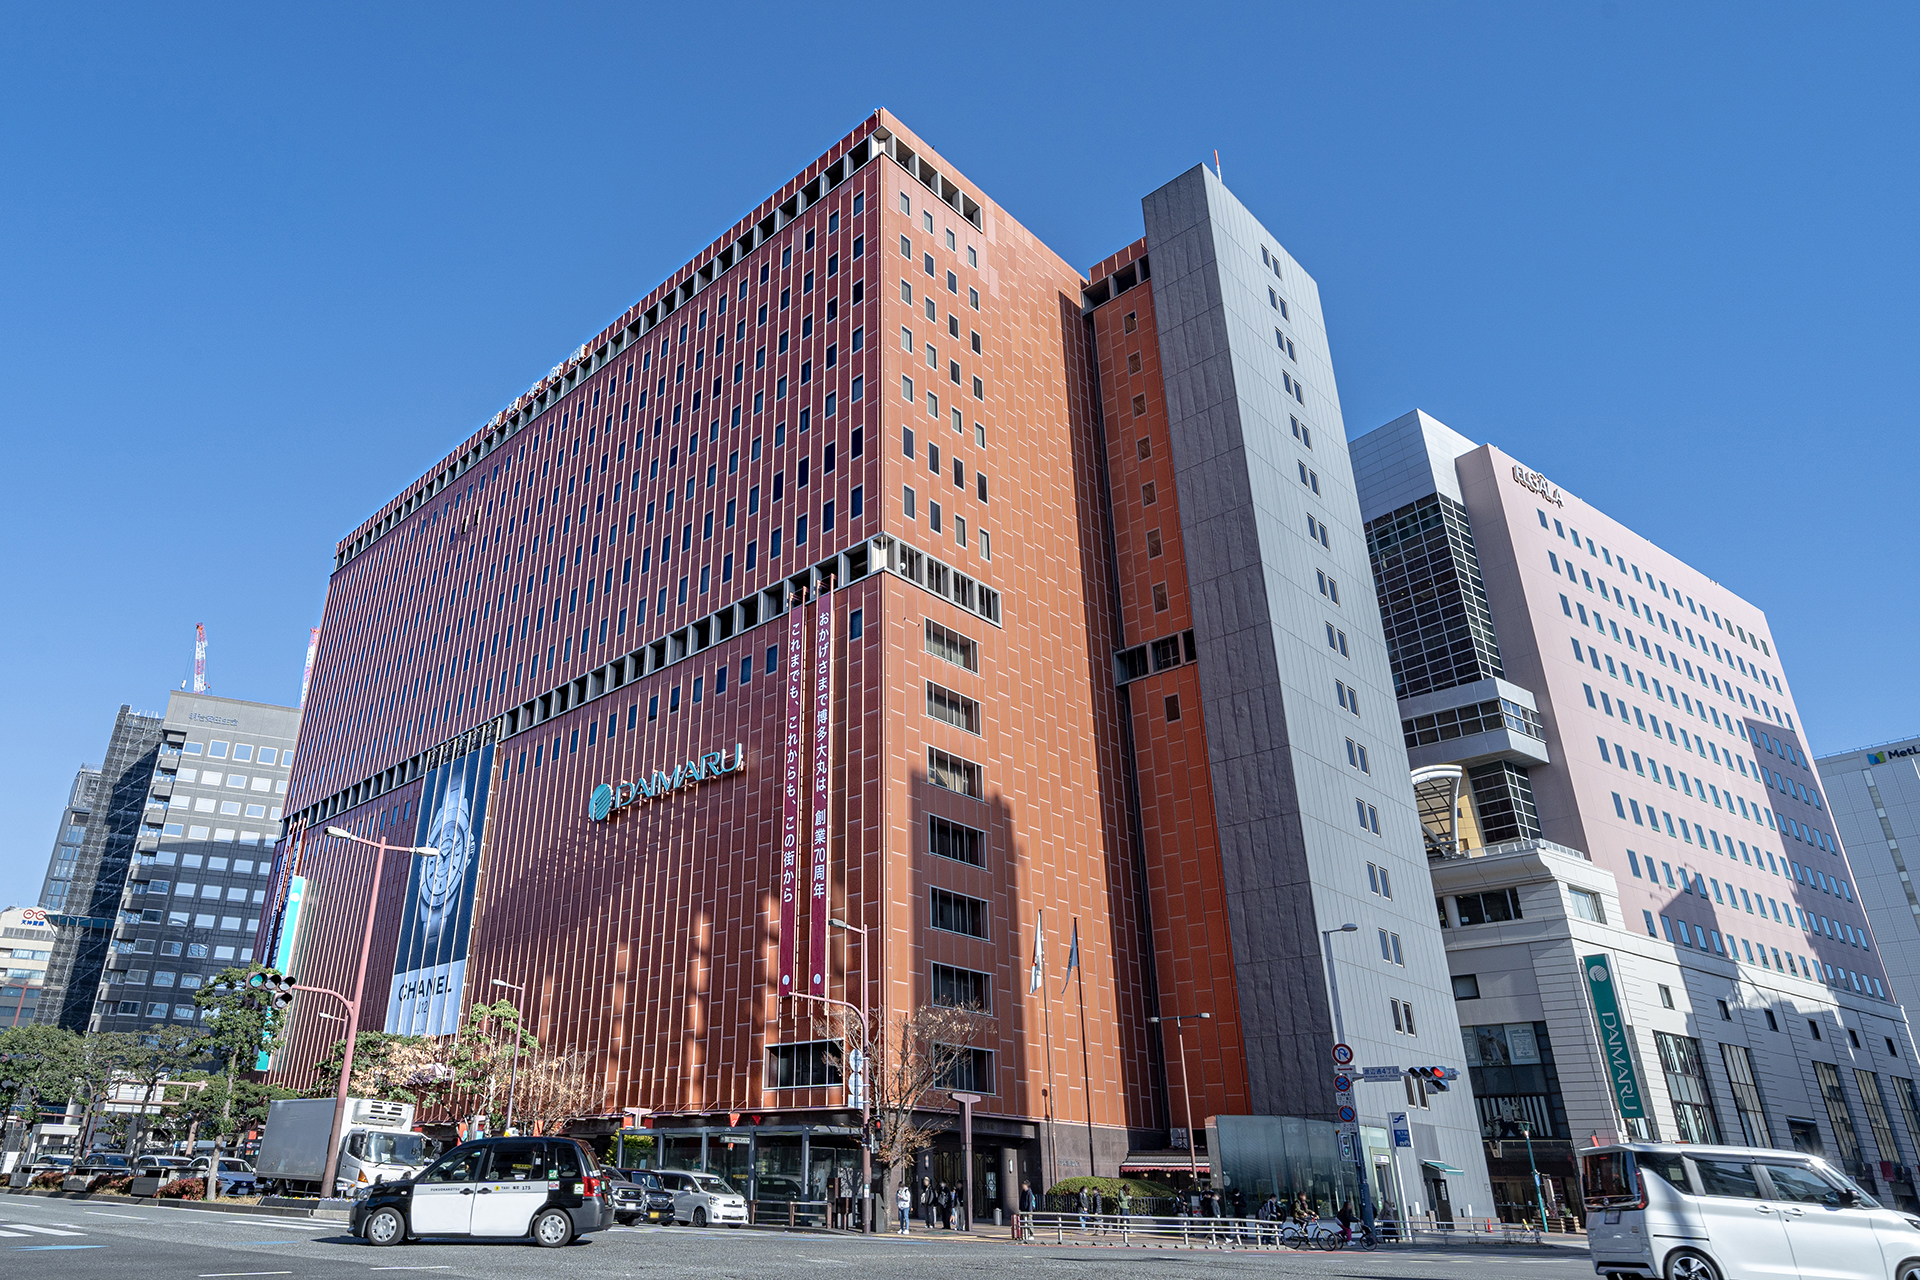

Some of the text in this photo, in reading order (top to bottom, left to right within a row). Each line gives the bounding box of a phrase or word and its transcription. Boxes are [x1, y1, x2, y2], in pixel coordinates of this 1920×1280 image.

[614, 742, 743, 809] DAIMARU
[783, 622, 800, 903] これまでも、これからも、この街から
[813, 612, 830, 900] おかげさまで博多大丸は、創業70周年
[1887, 744, 1920, 760] MetL
[398, 974, 452, 1002] CHANEL
[416, 1000, 429, 1015] J12
[1601, 1011, 1638, 1110] DAIMARU
